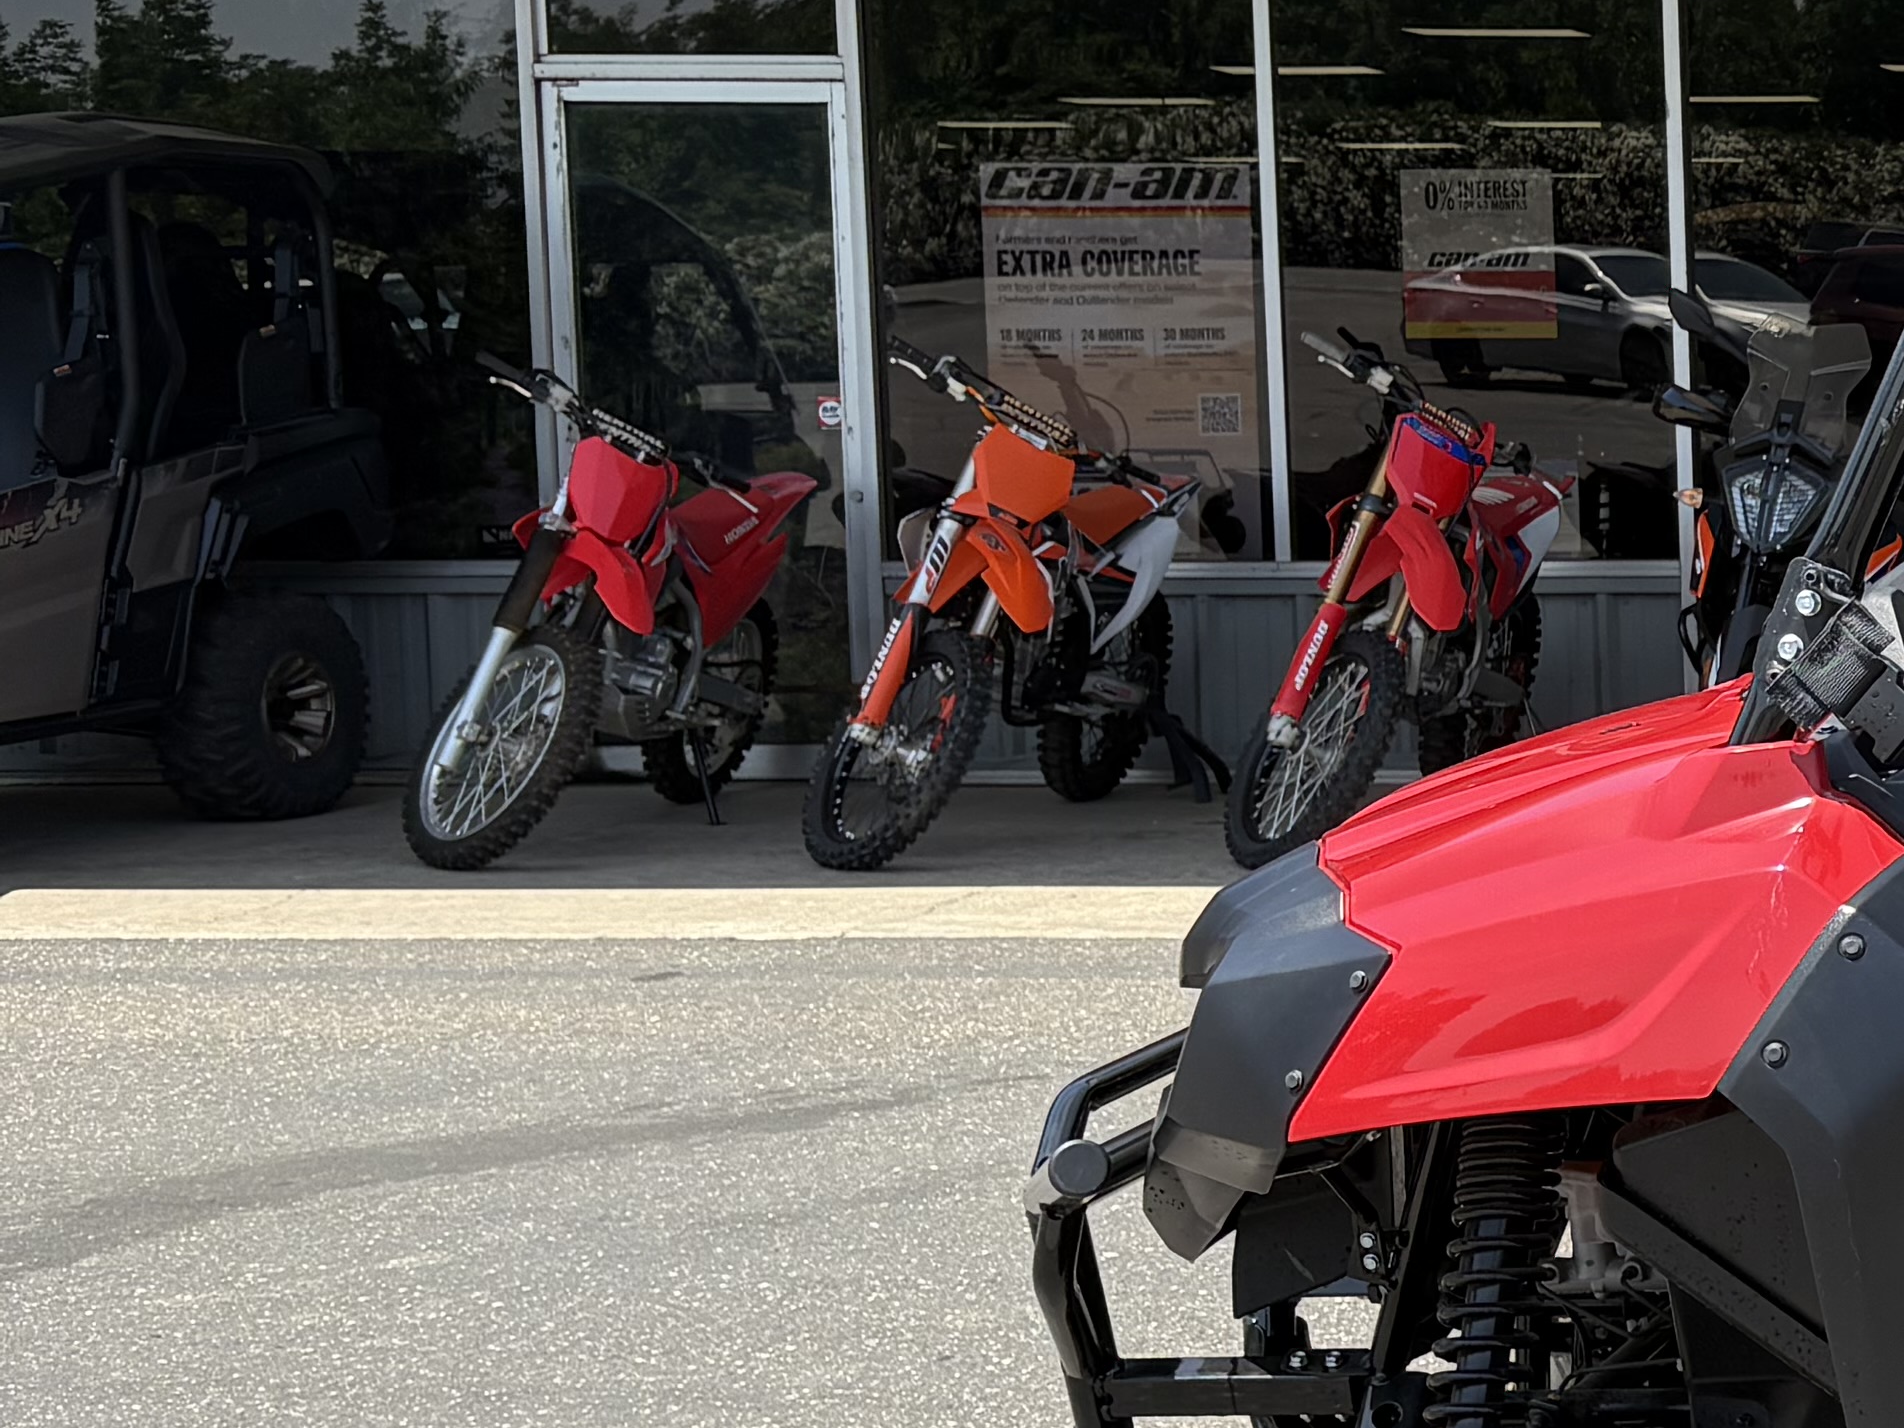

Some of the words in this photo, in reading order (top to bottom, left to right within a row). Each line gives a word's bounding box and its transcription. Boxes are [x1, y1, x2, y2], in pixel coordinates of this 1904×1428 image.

[1424, 180, 1455, 211] 0%
[1457, 180, 1528, 199] INTEREST
[996, 249, 1071, 277] EXTRA
[1081, 249, 1202, 277] COVERAGE
[1015, 328, 1062, 342] MONTHS
[1081, 328, 1095, 342] 24
[1098, 328, 1144, 342] MONTHS
[1163, 328, 1177, 341] 30
[1179, 327, 1226, 341] MONTHS
